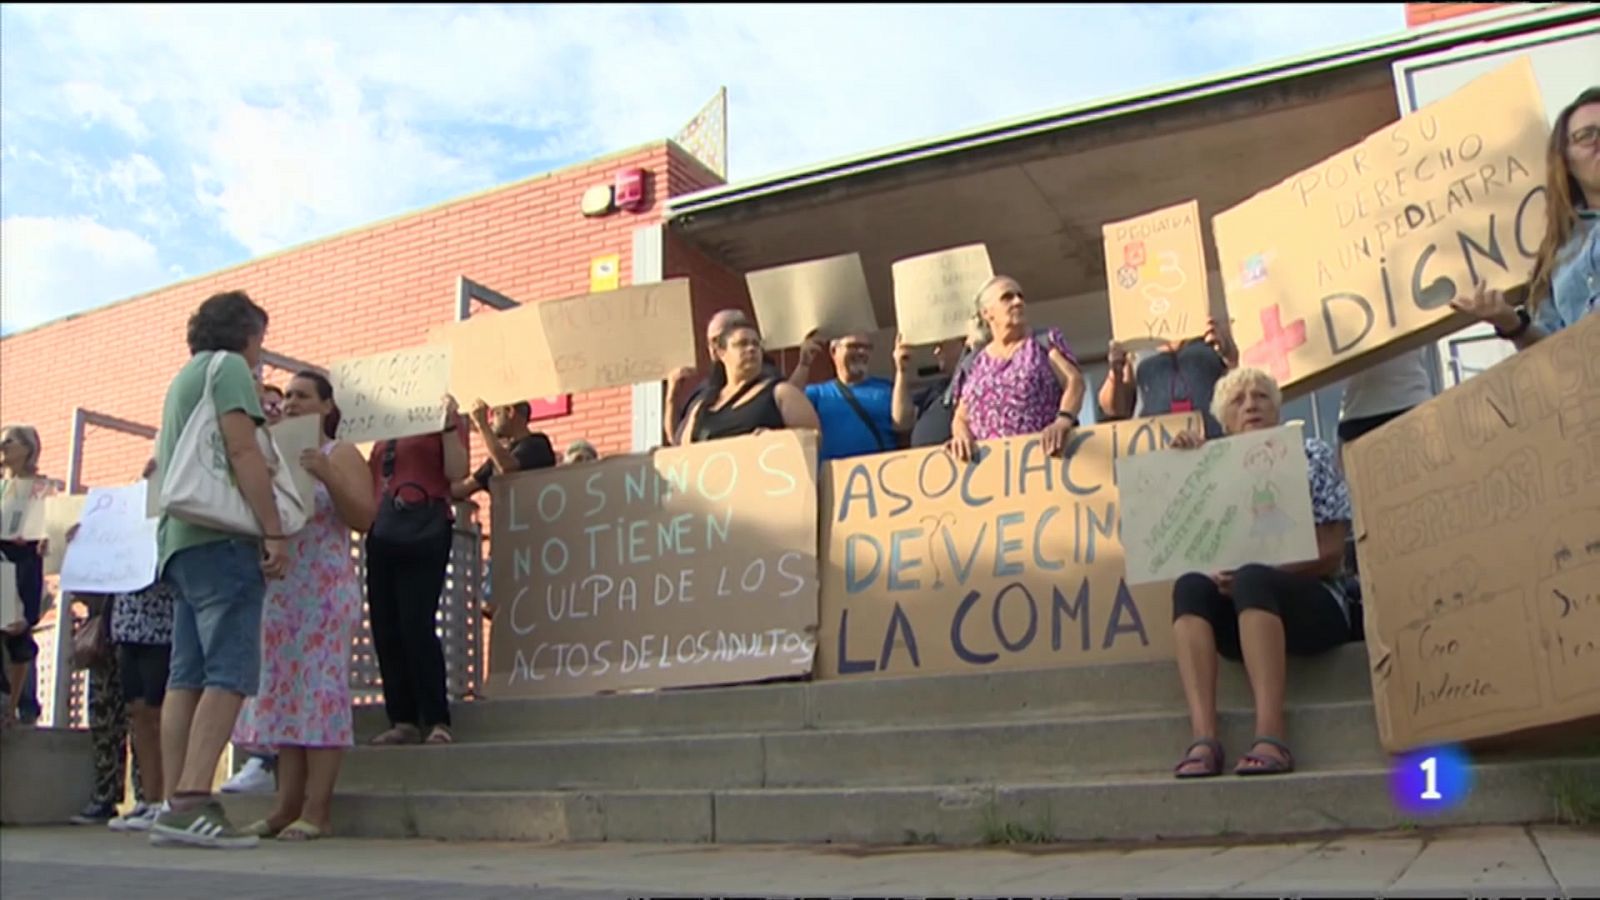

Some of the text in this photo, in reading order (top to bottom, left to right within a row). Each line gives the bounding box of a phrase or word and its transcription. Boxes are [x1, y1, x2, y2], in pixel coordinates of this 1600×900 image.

[1291, 115, 1438, 208] POR SU
[1335, 133, 1483, 229] DERECHO
[509, 471, 606, 532] LOS
[513, 537, 570, 581] NO
[844, 526, 924, 594] DE
[941, 502, 1122, 586] VECIN
[509, 552, 806, 635] CULPA DE LOS
[837, 575, 1150, 675] LA COMA
[508, 640, 614, 687] ACTOS
[712, 627, 817, 665] ADULTOS
